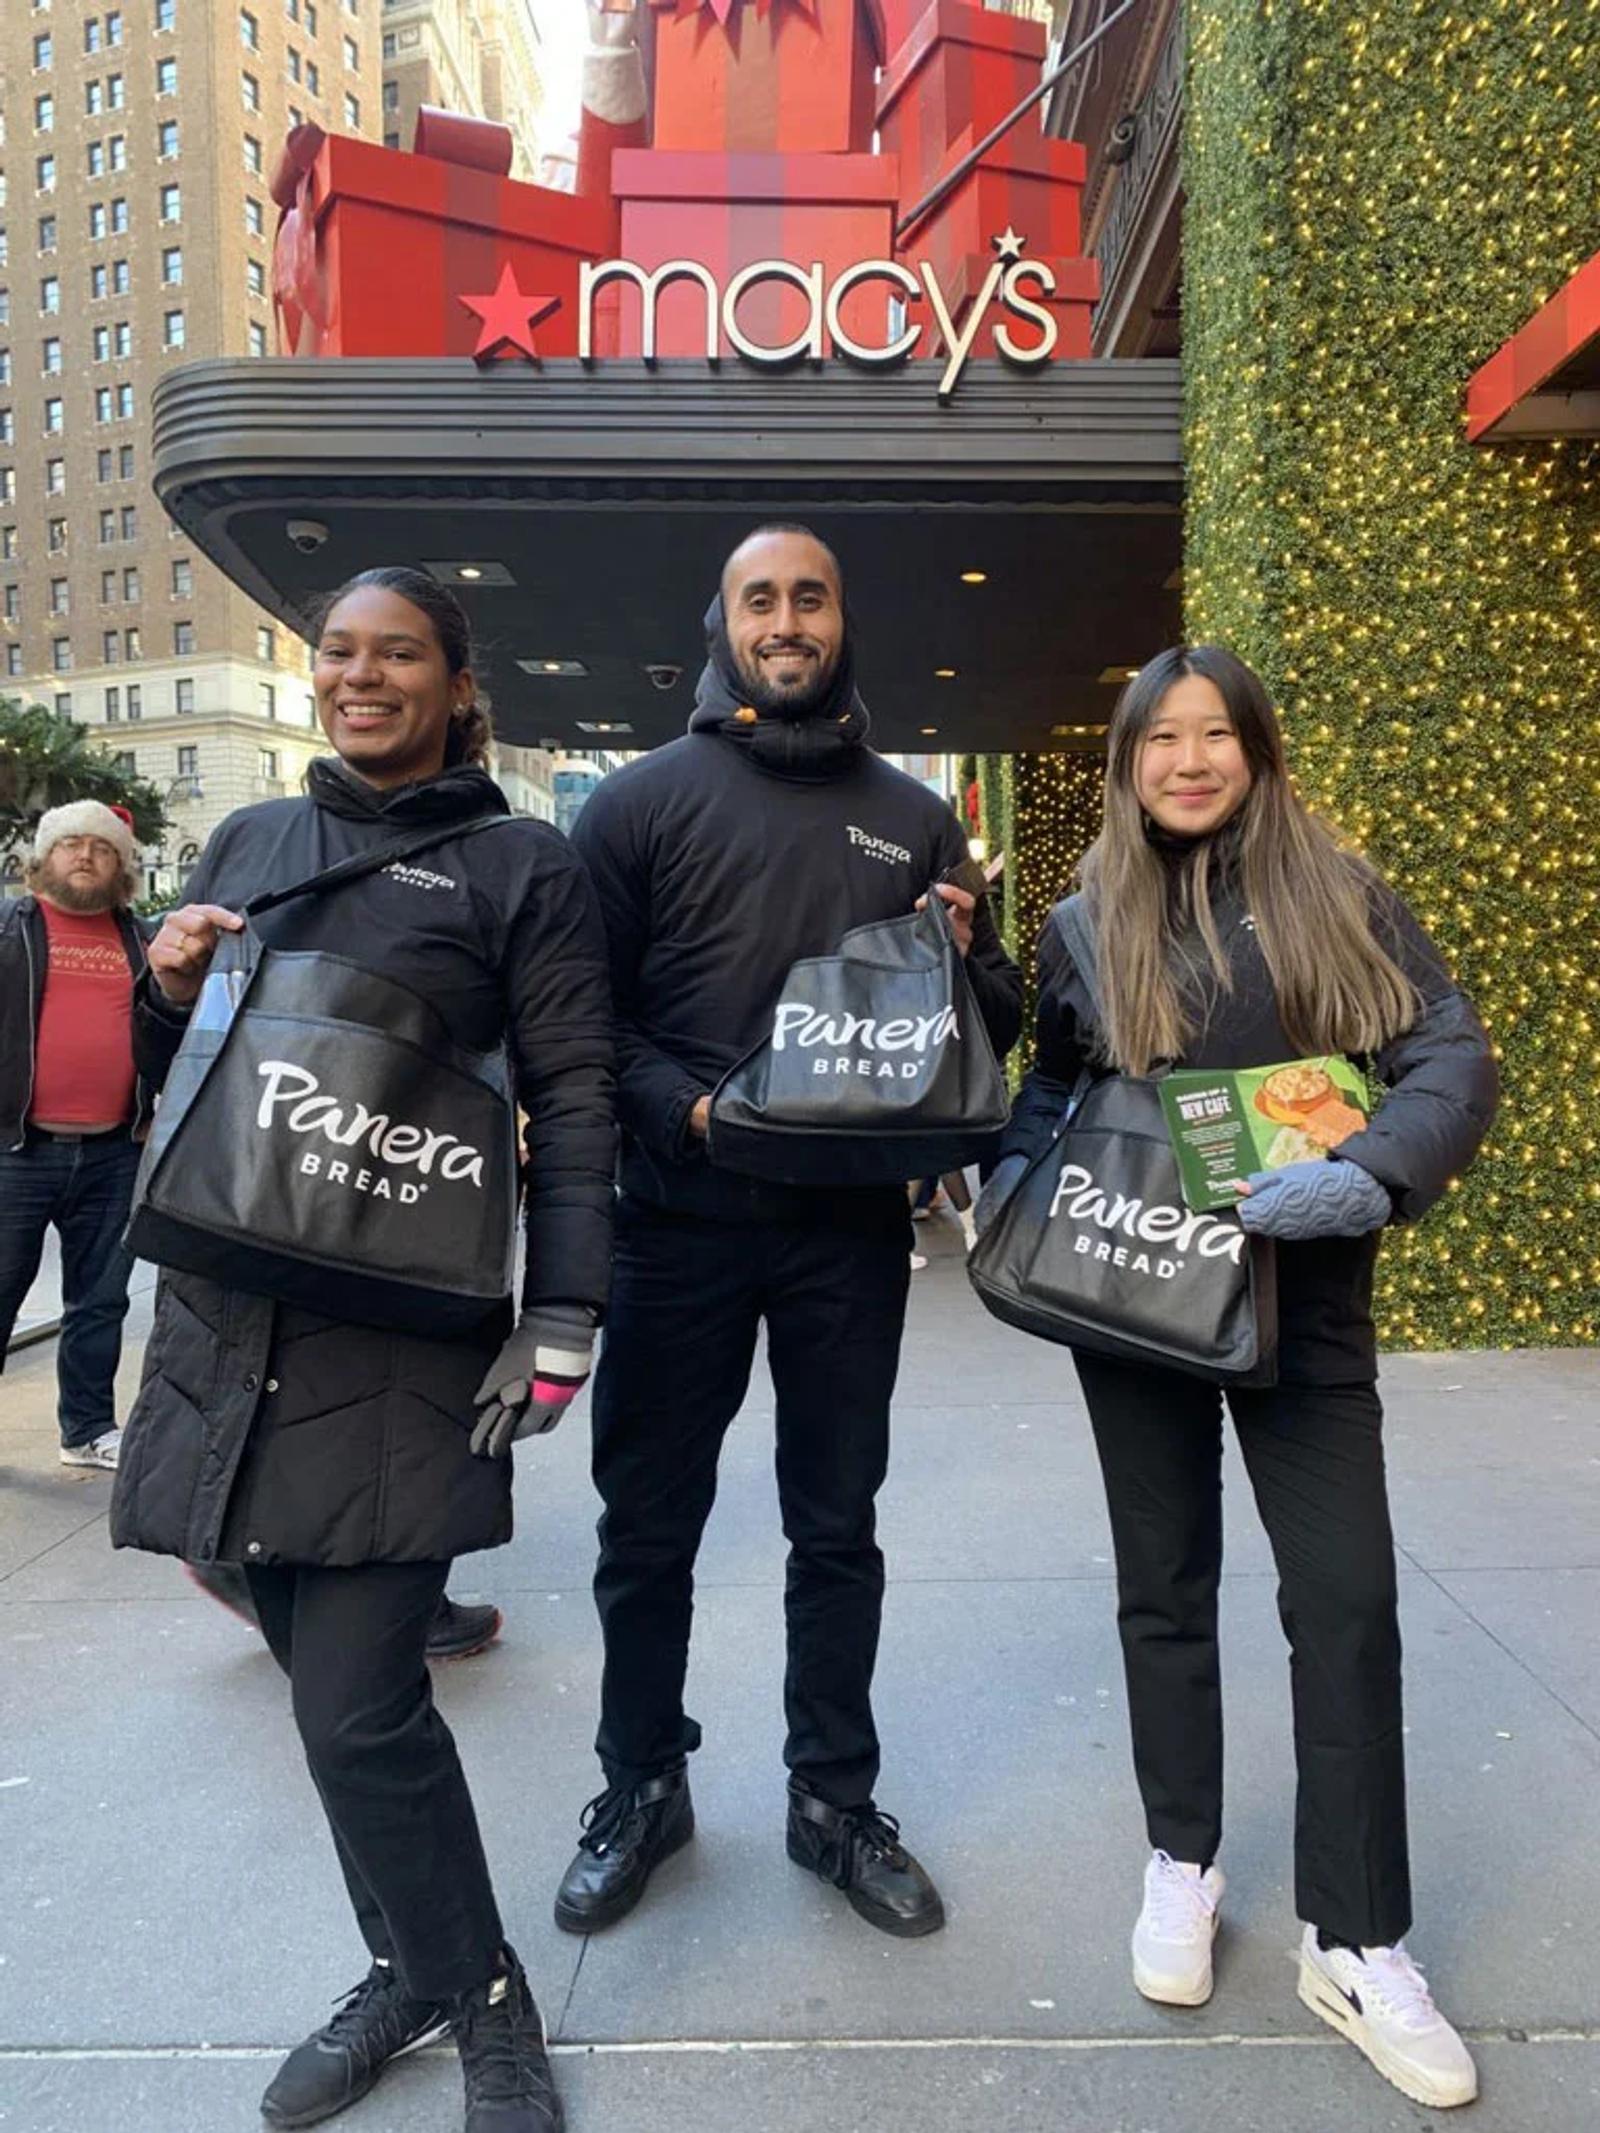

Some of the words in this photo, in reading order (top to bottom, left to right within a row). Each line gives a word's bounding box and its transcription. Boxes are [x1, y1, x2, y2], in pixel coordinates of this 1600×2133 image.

[845, 824, 912, 864] Panera
[771, 1003, 961, 1053] Panera
[812, 1056, 918, 1079] BREAD
[257, 1060, 484, 1188] Panera
[299, 1152, 420, 1204] BREAD
[1048, 1163, 1246, 1266] Panera
[1073, 1234, 1177, 1279] BREAD
